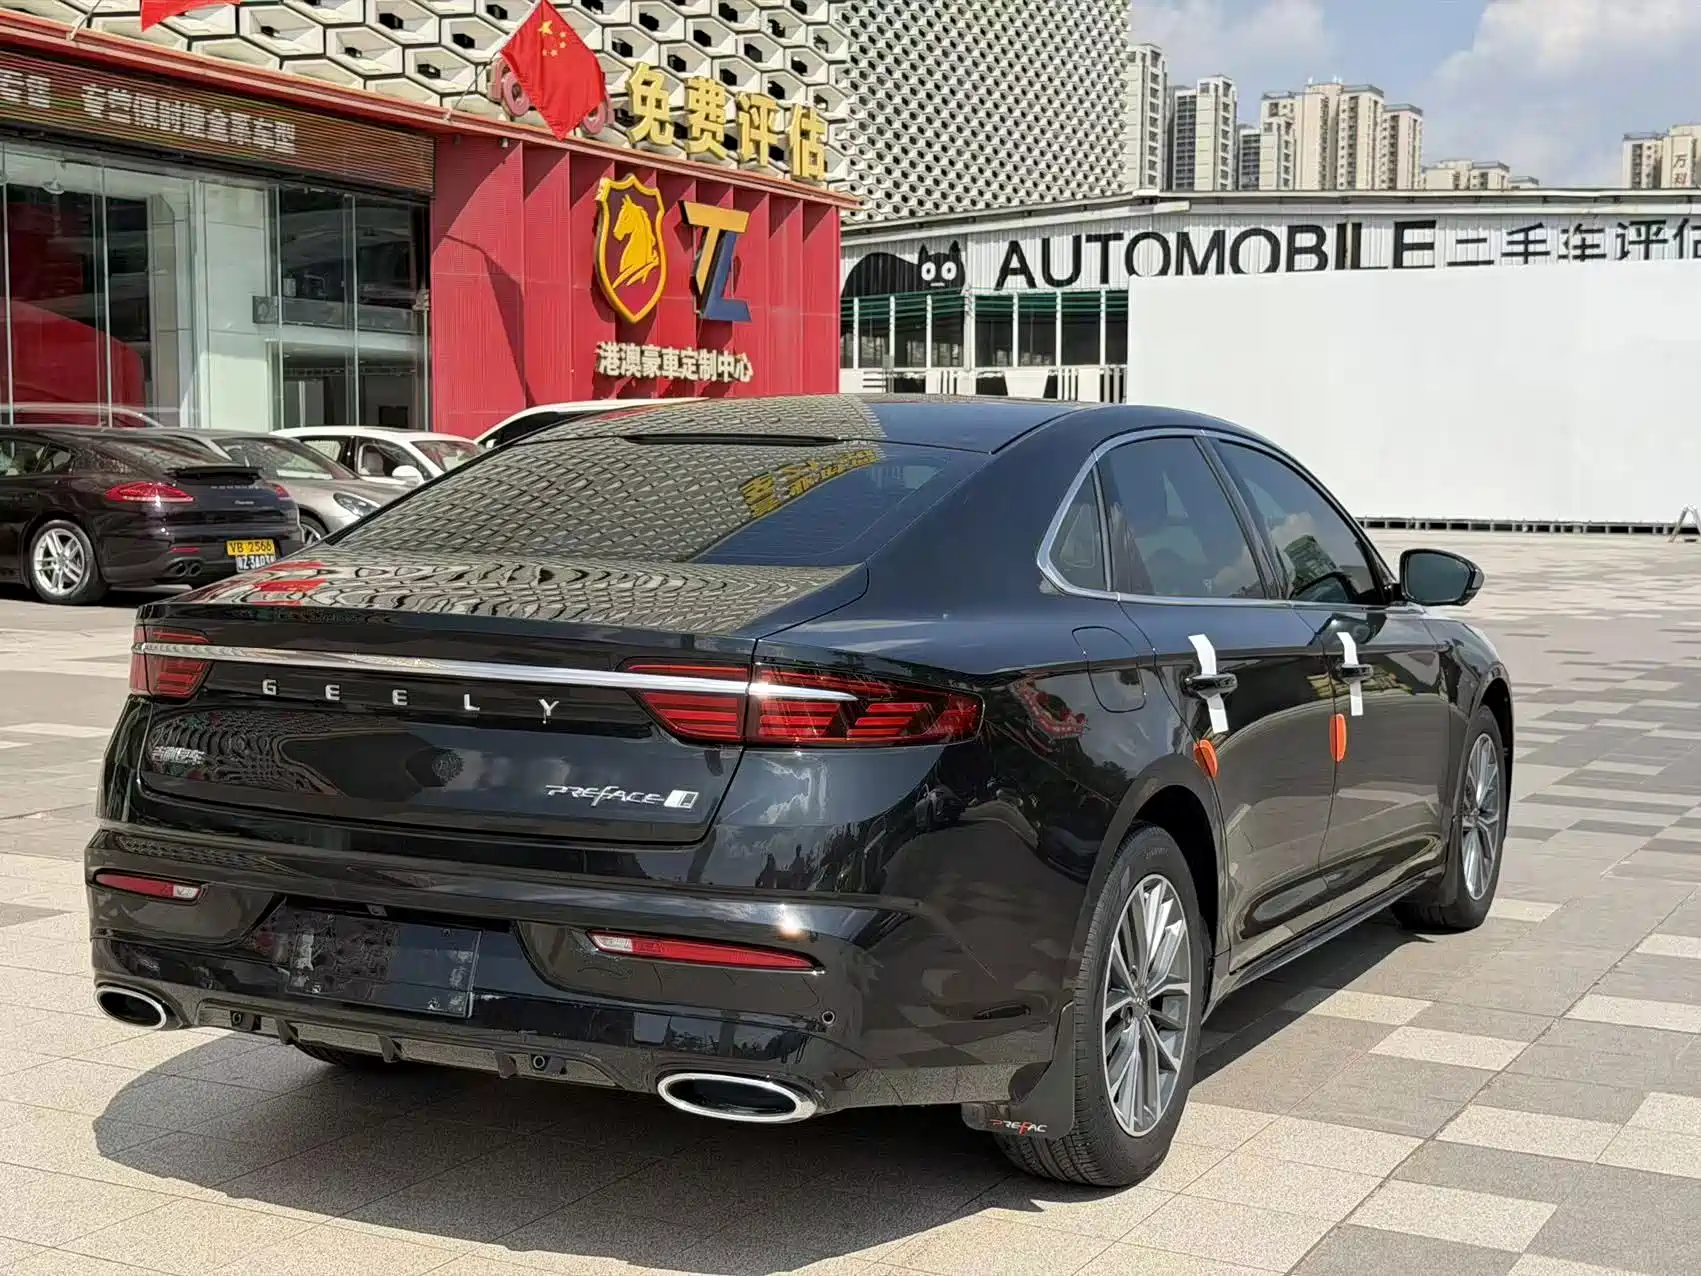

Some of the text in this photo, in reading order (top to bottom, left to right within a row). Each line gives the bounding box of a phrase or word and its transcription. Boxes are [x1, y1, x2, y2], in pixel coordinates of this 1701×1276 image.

[626, 62, 826, 182] 免费评估
[1673, 153, 1688, 185] 万科
[994, 219, 1437, 291] AUTOMOBILE
[597, 341, 754, 383] 港澳豪車定制中心
[229, 542, 244, 553] VB
[262, 679, 559, 724] GEELY
[545, 784, 665, 807] PREFACE
